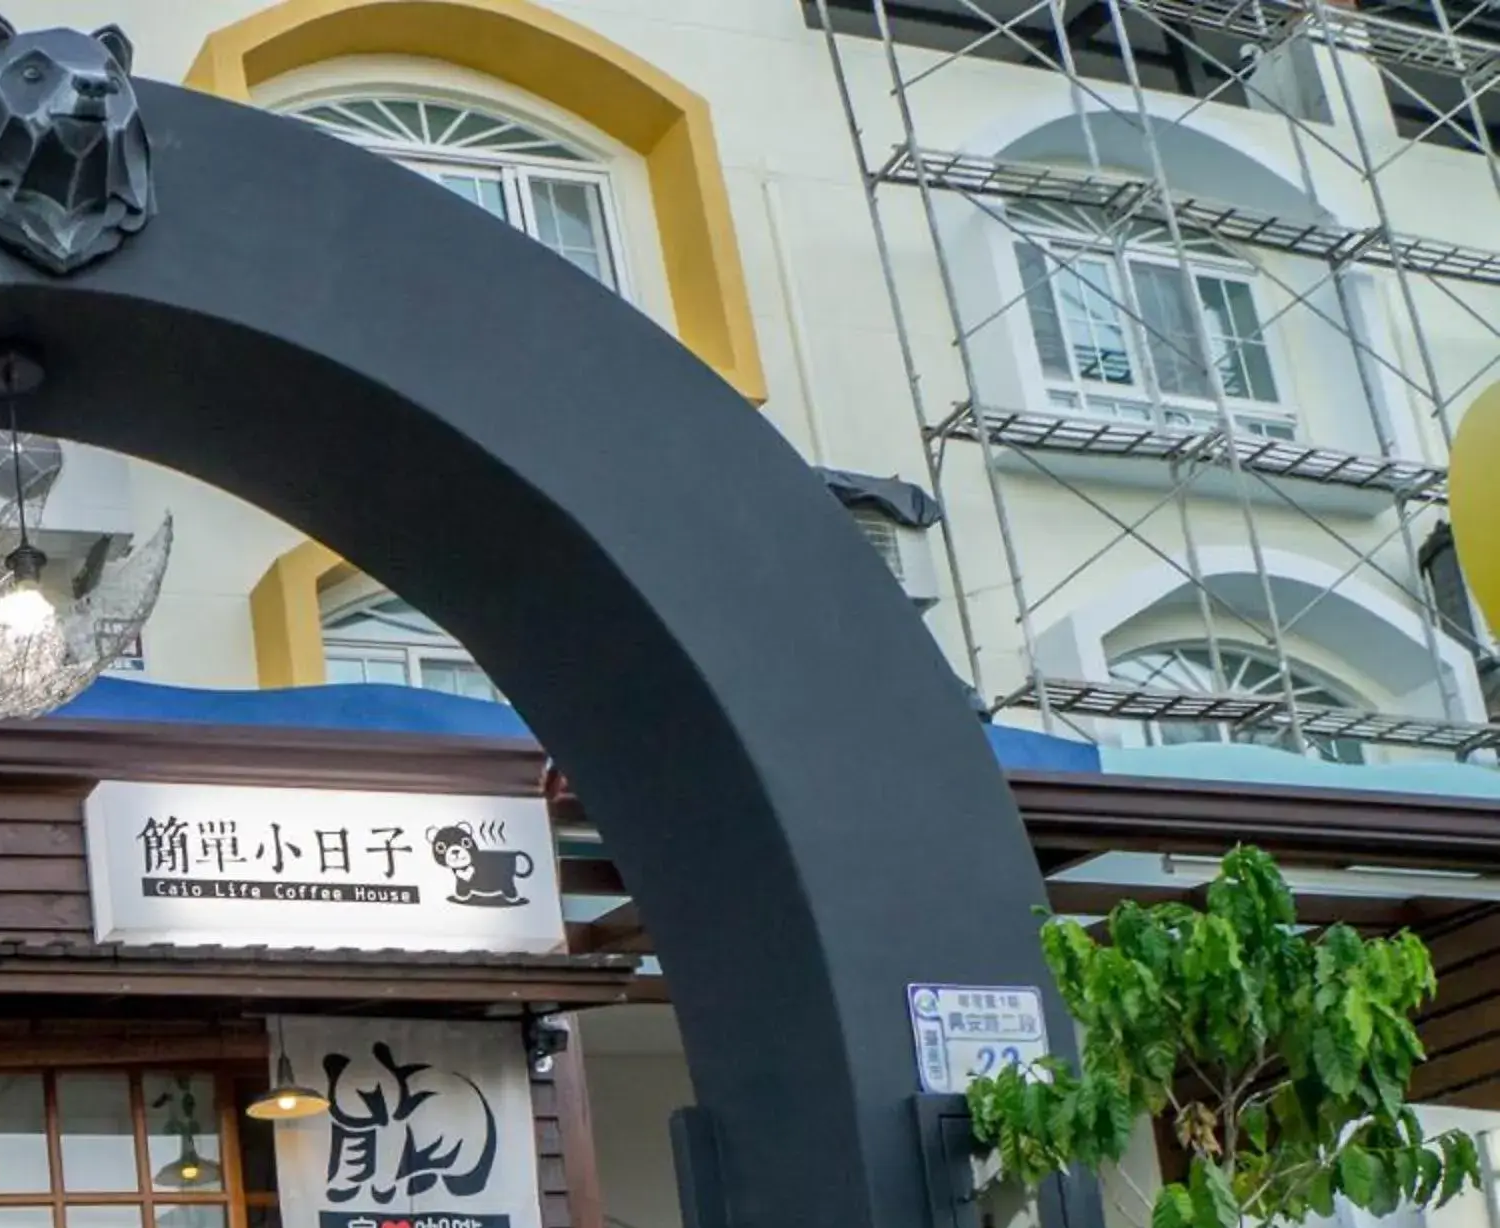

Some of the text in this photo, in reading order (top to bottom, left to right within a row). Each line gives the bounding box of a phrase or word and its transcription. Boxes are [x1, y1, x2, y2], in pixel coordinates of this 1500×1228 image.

[136, 815, 413, 879] 簡單小日子
[214, 882, 261, 898] Life
[273, 883, 343, 899] Coffee
[354, 886, 412, 903] House
